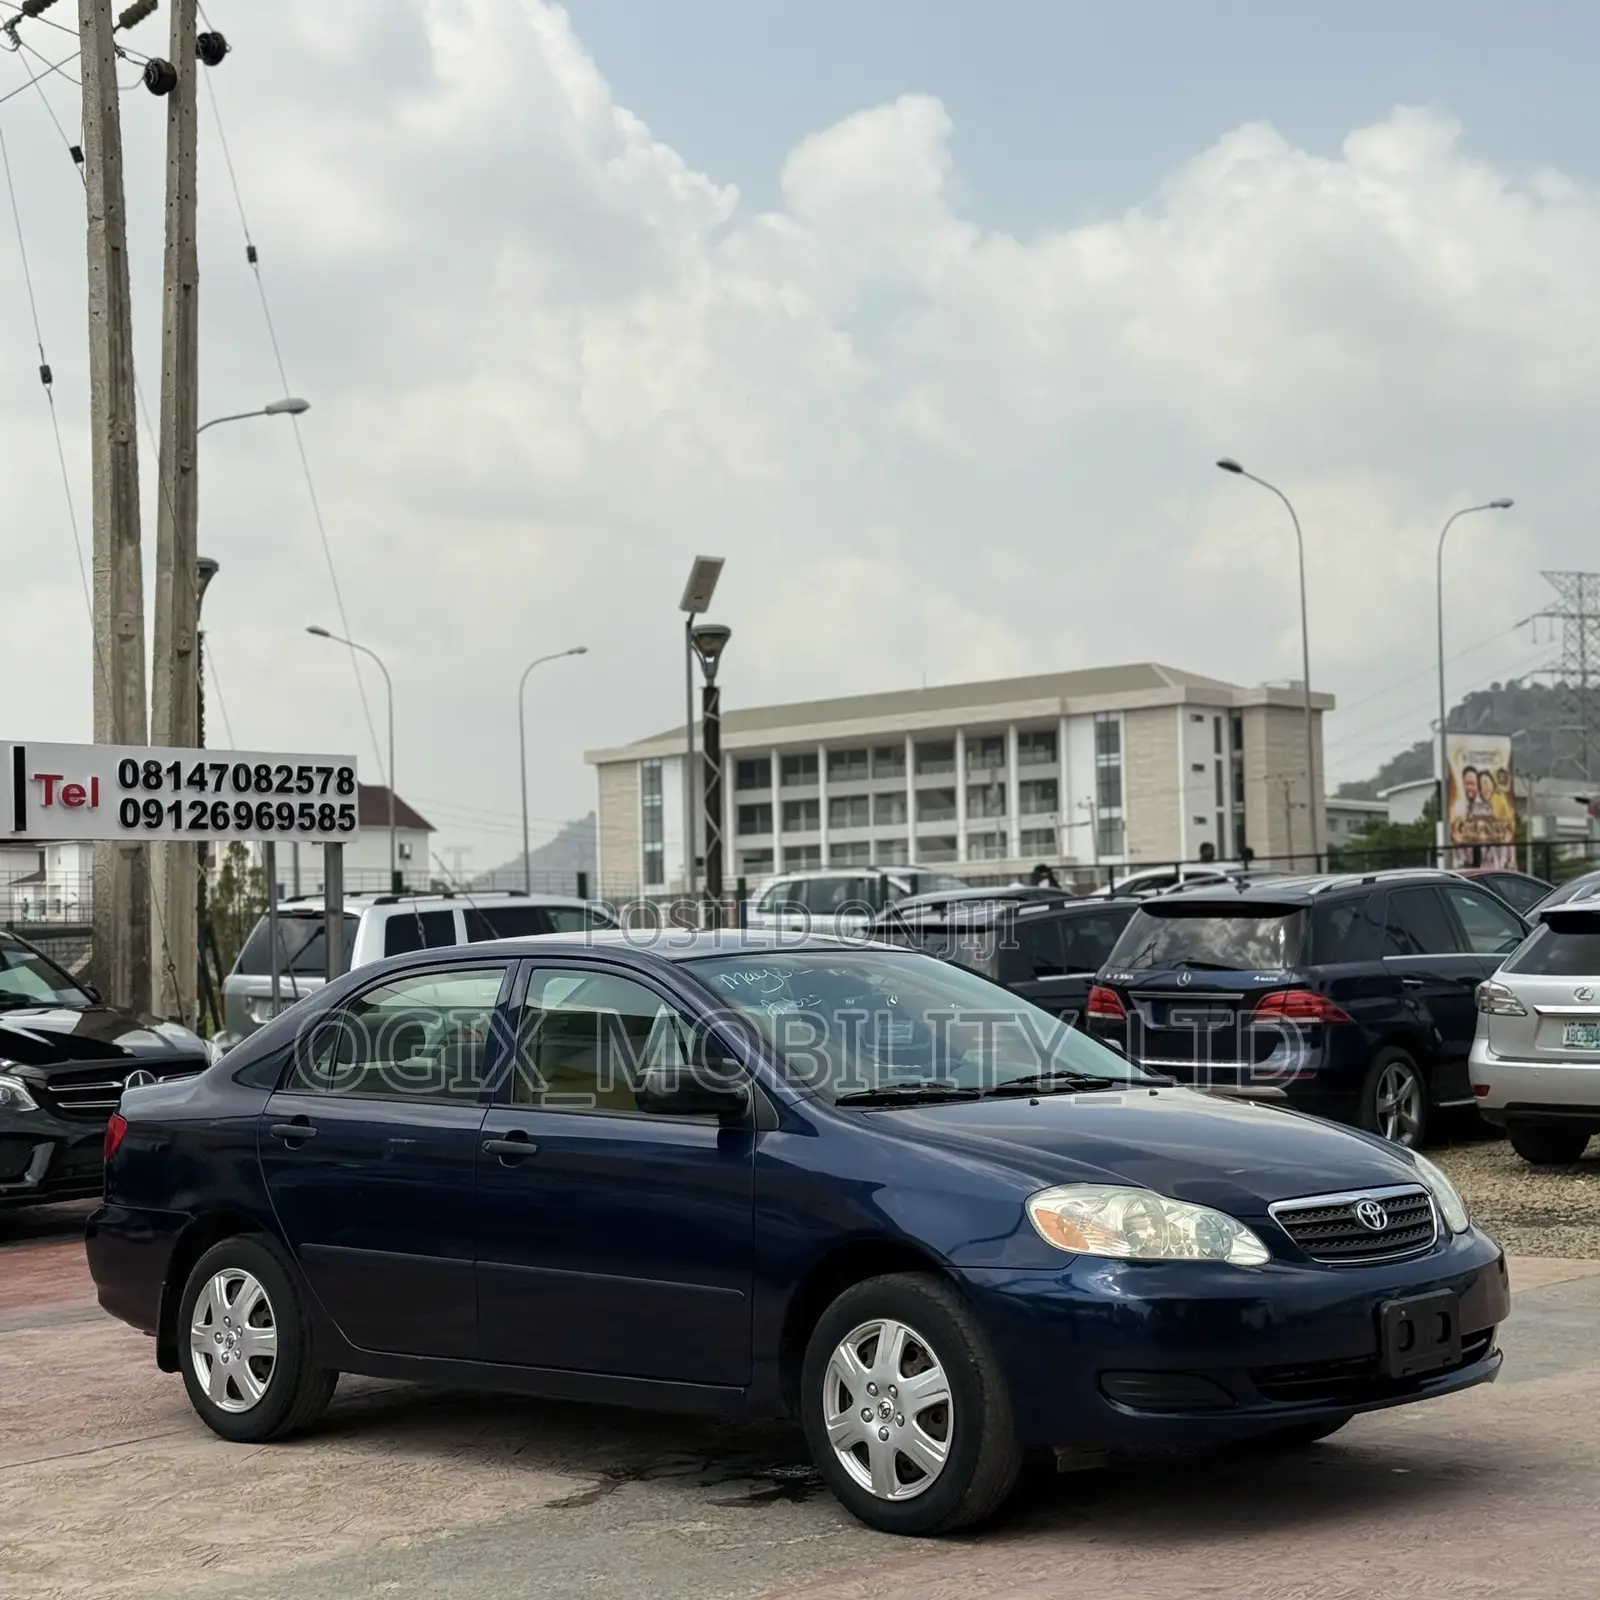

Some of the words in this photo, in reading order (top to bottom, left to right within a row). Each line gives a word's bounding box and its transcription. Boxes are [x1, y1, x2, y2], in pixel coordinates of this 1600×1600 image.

[33, 773, 99, 808] Tel
[118, 758, 355, 795] 08147082578
[119, 798, 356, 831] 09126969585
